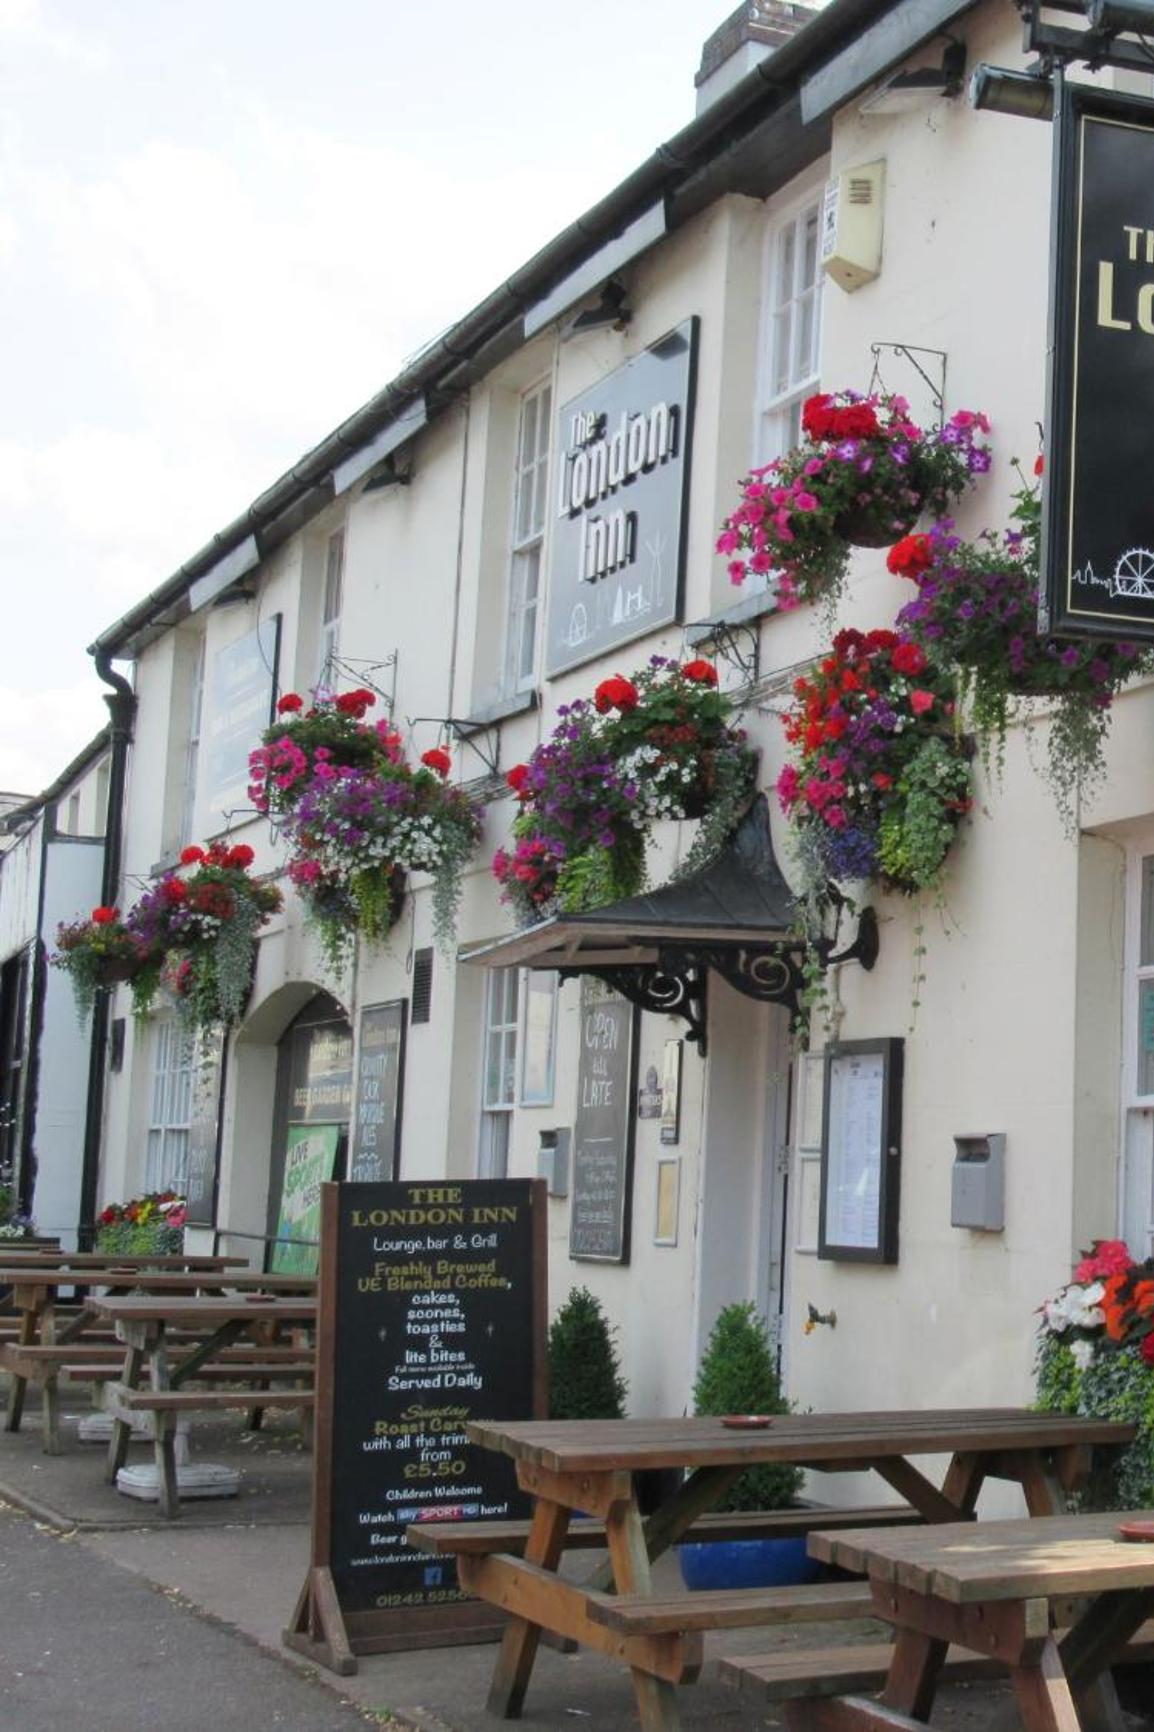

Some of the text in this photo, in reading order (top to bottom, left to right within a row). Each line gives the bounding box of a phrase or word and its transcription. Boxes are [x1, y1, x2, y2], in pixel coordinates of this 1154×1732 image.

[571, 410, 596, 449] The
[558, 402, 675, 519] London
[578, 508, 632, 584] Inn
[408, 1188, 462, 1204] THE
[352, 1206, 518, 1227] LONDON INN
[453, 1234, 468, 1249] &
[471, 1233, 498, 1248] Grill
[374, 1259, 496, 1279] Freshly Brewed
[387, 1275, 450, 1290] Blended
[406, 1321, 466, 1334] toasties
[429, 1334, 443, 1348] &
[431, 1349, 466, 1362] bites
[388, 1372, 482, 1391] Served Daily
[363, 1437, 391, 1451] with
[396, 1435, 410, 1448] all
[415, 1433, 436, 1447] the
[420, 1448, 452, 1462] from
[386, 1486, 482, 1501] Children Welcome
